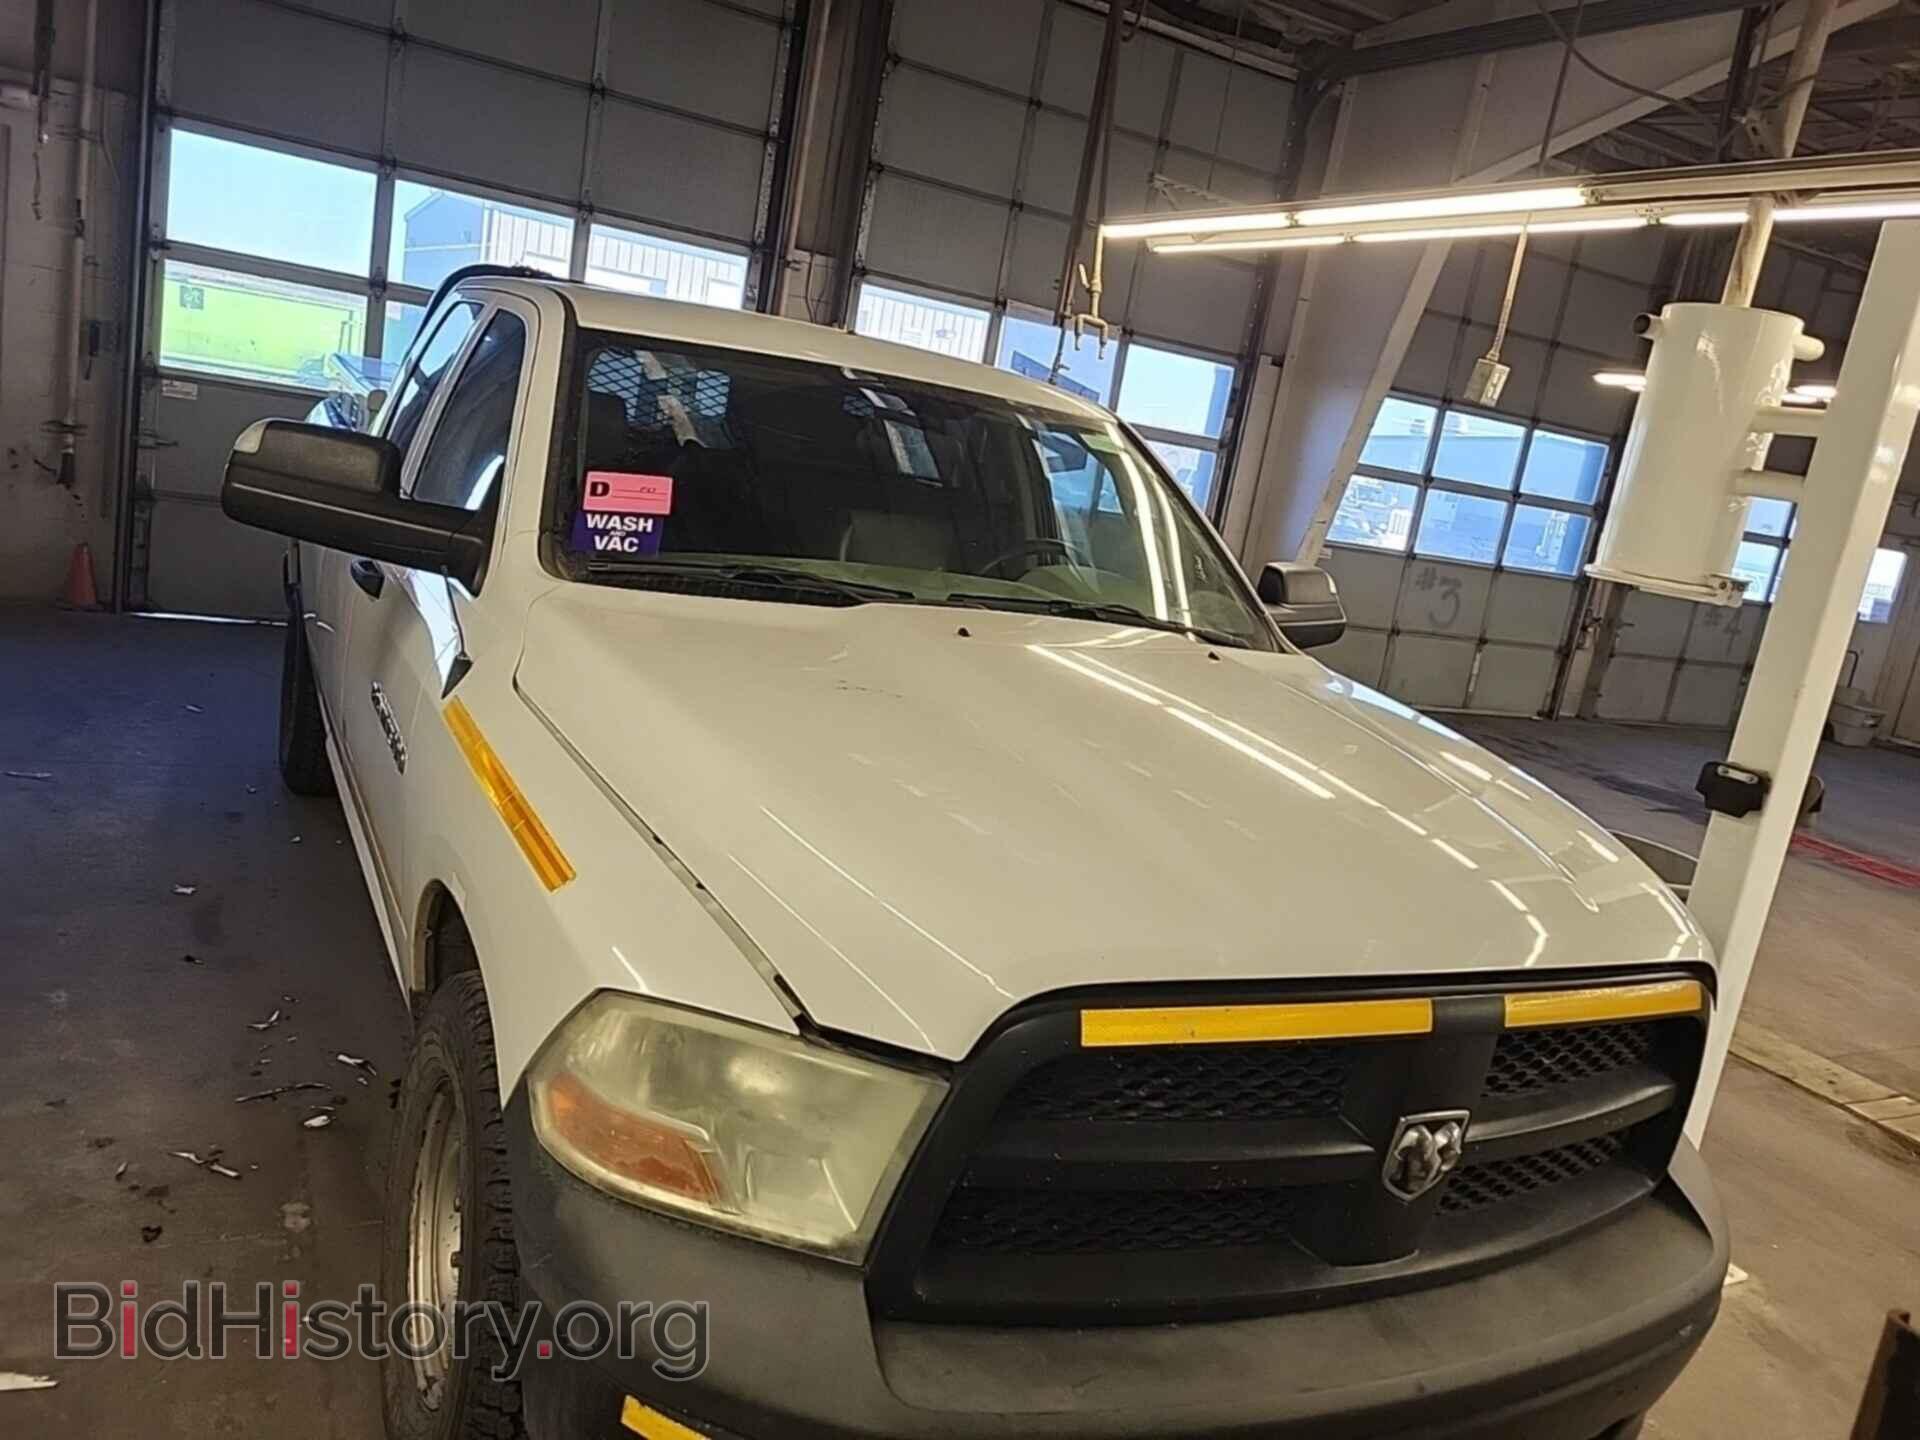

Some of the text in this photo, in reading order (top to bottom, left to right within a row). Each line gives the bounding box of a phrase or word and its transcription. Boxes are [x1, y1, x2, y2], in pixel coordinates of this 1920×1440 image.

[589, 481, 610, 497] D
[586, 513, 654, 533] WASH
[594, 535, 639, 553] VAC
[1415, 567, 1462, 629] #3
